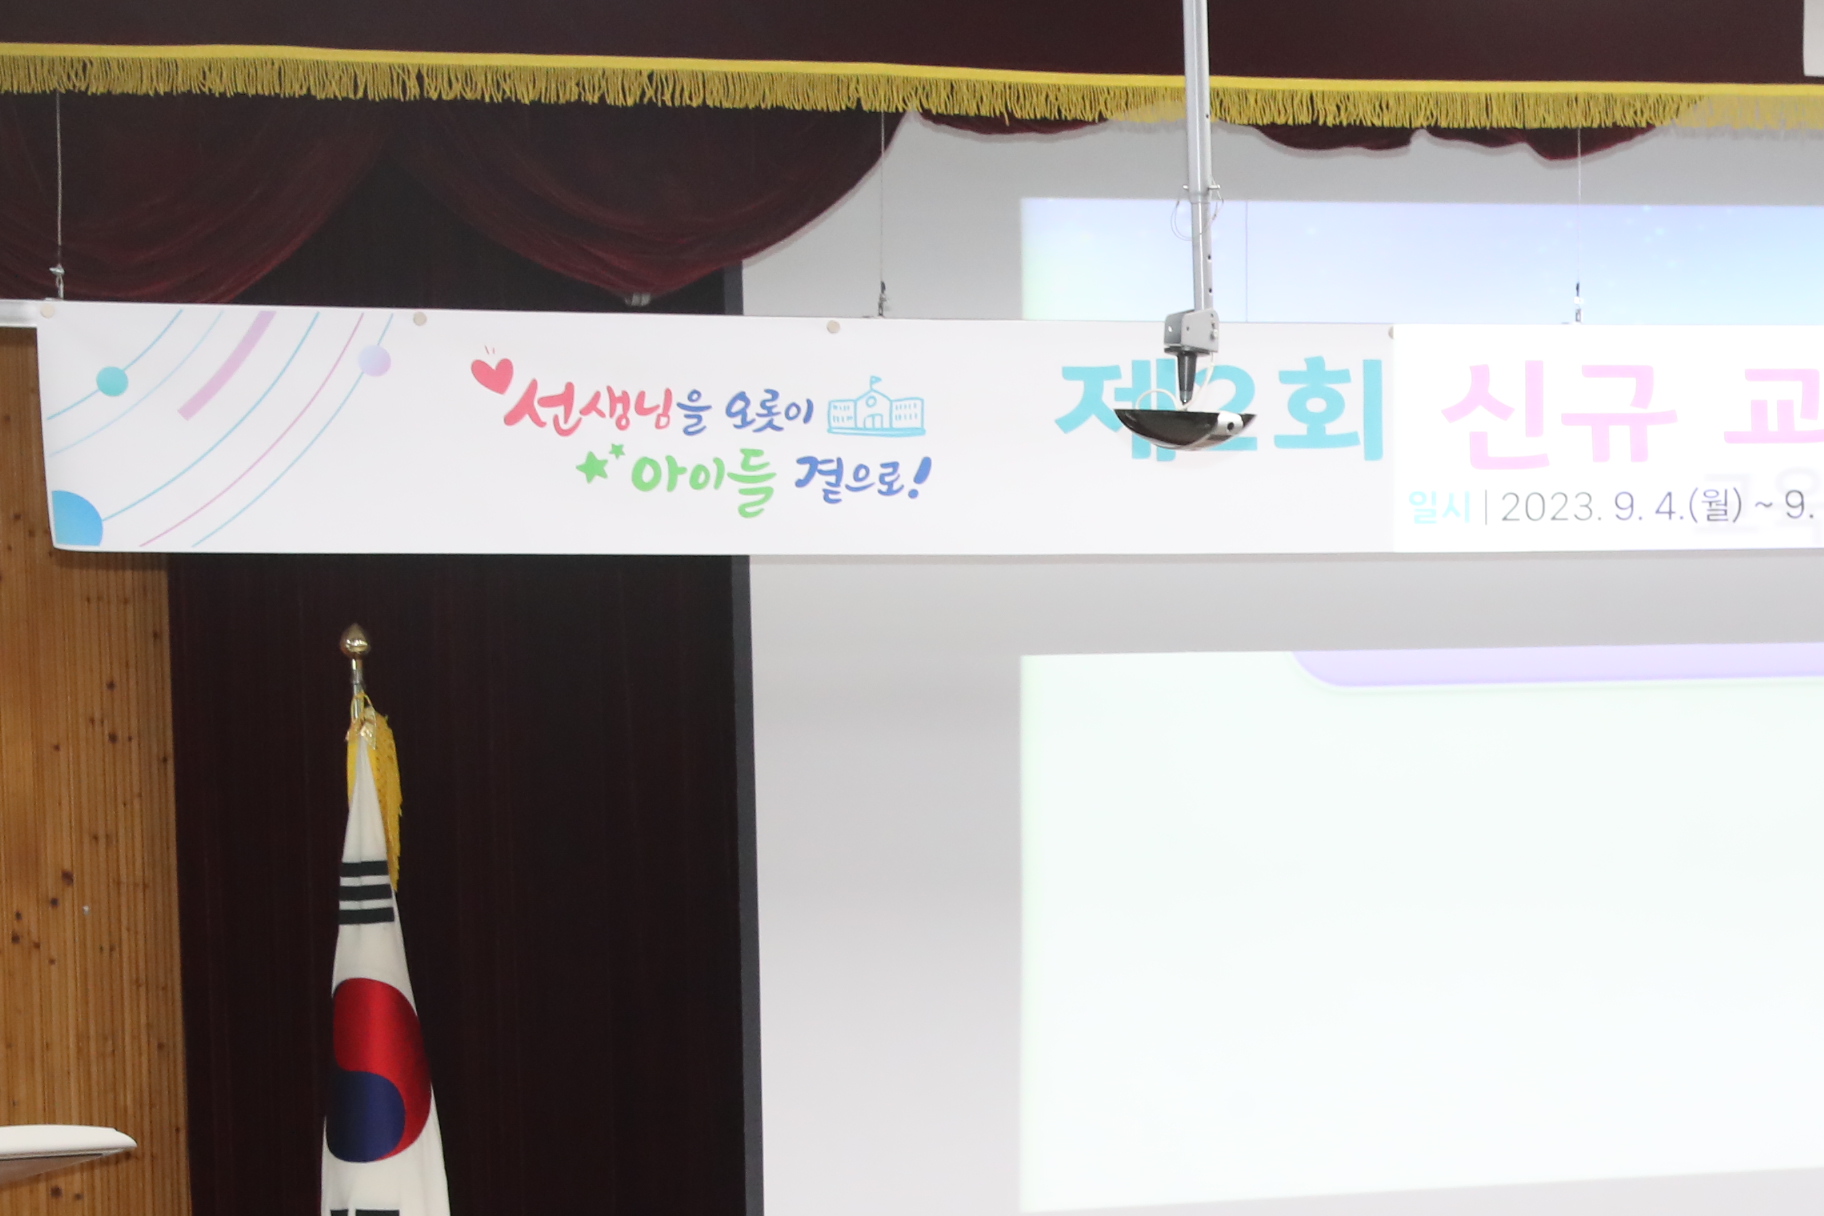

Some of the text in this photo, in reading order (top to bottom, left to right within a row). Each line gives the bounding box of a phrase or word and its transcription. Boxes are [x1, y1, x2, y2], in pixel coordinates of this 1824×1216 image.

[503, 378, 814, 437] 선생님을 오롯이
[1441, 360, 1679, 470] 신규
[631, 448, 932, 519] 아이들 곁으로!
[1408, 490, 1471, 525] 일시
[1501, 491, 1603, 522] 2023.
